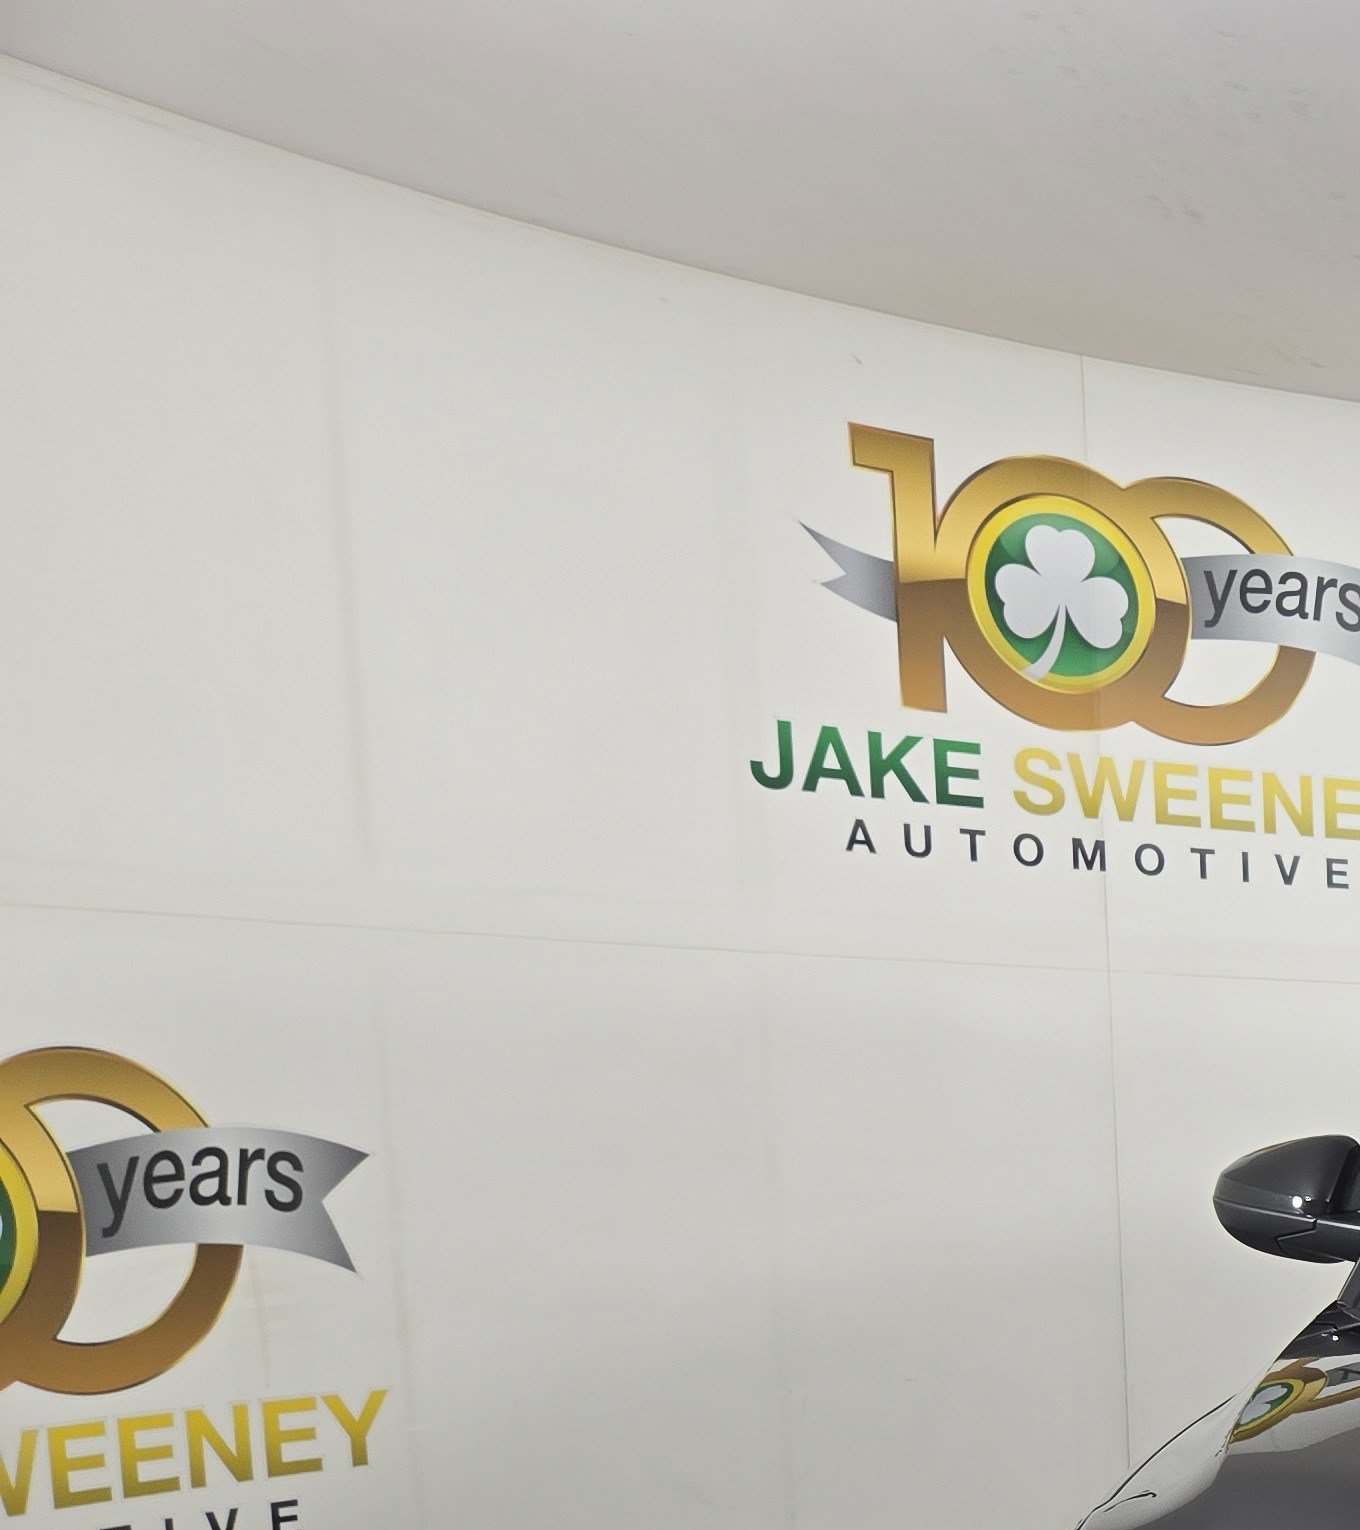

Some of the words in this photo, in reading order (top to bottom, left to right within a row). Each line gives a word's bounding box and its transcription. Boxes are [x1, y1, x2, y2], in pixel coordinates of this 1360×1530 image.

[750, 719, 986, 809] JAKE
[845, 818, 1351, 890] AUTOMOTIVE
[96, 1144, 304, 1238] years
